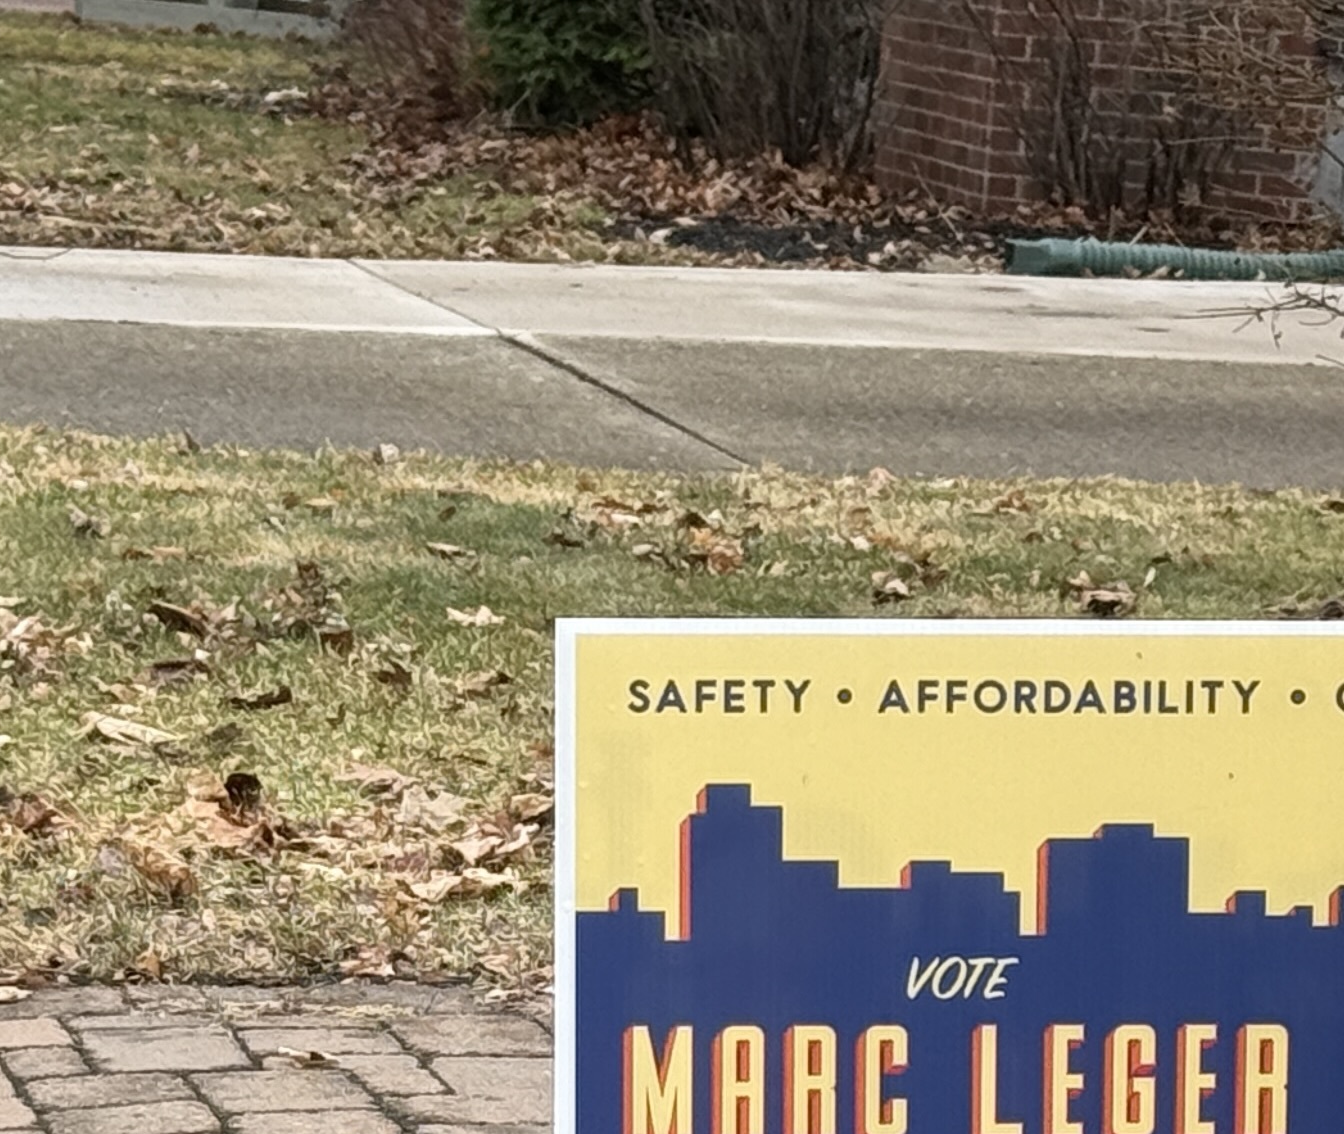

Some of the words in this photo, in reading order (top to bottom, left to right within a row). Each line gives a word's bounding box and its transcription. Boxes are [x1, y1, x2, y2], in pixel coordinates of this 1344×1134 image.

[628, 679, 811, 714] SAFETY
[878, 679, 1261, 714] AFFORDABILITY
[906, 956, 1020, 1000] VOTE
